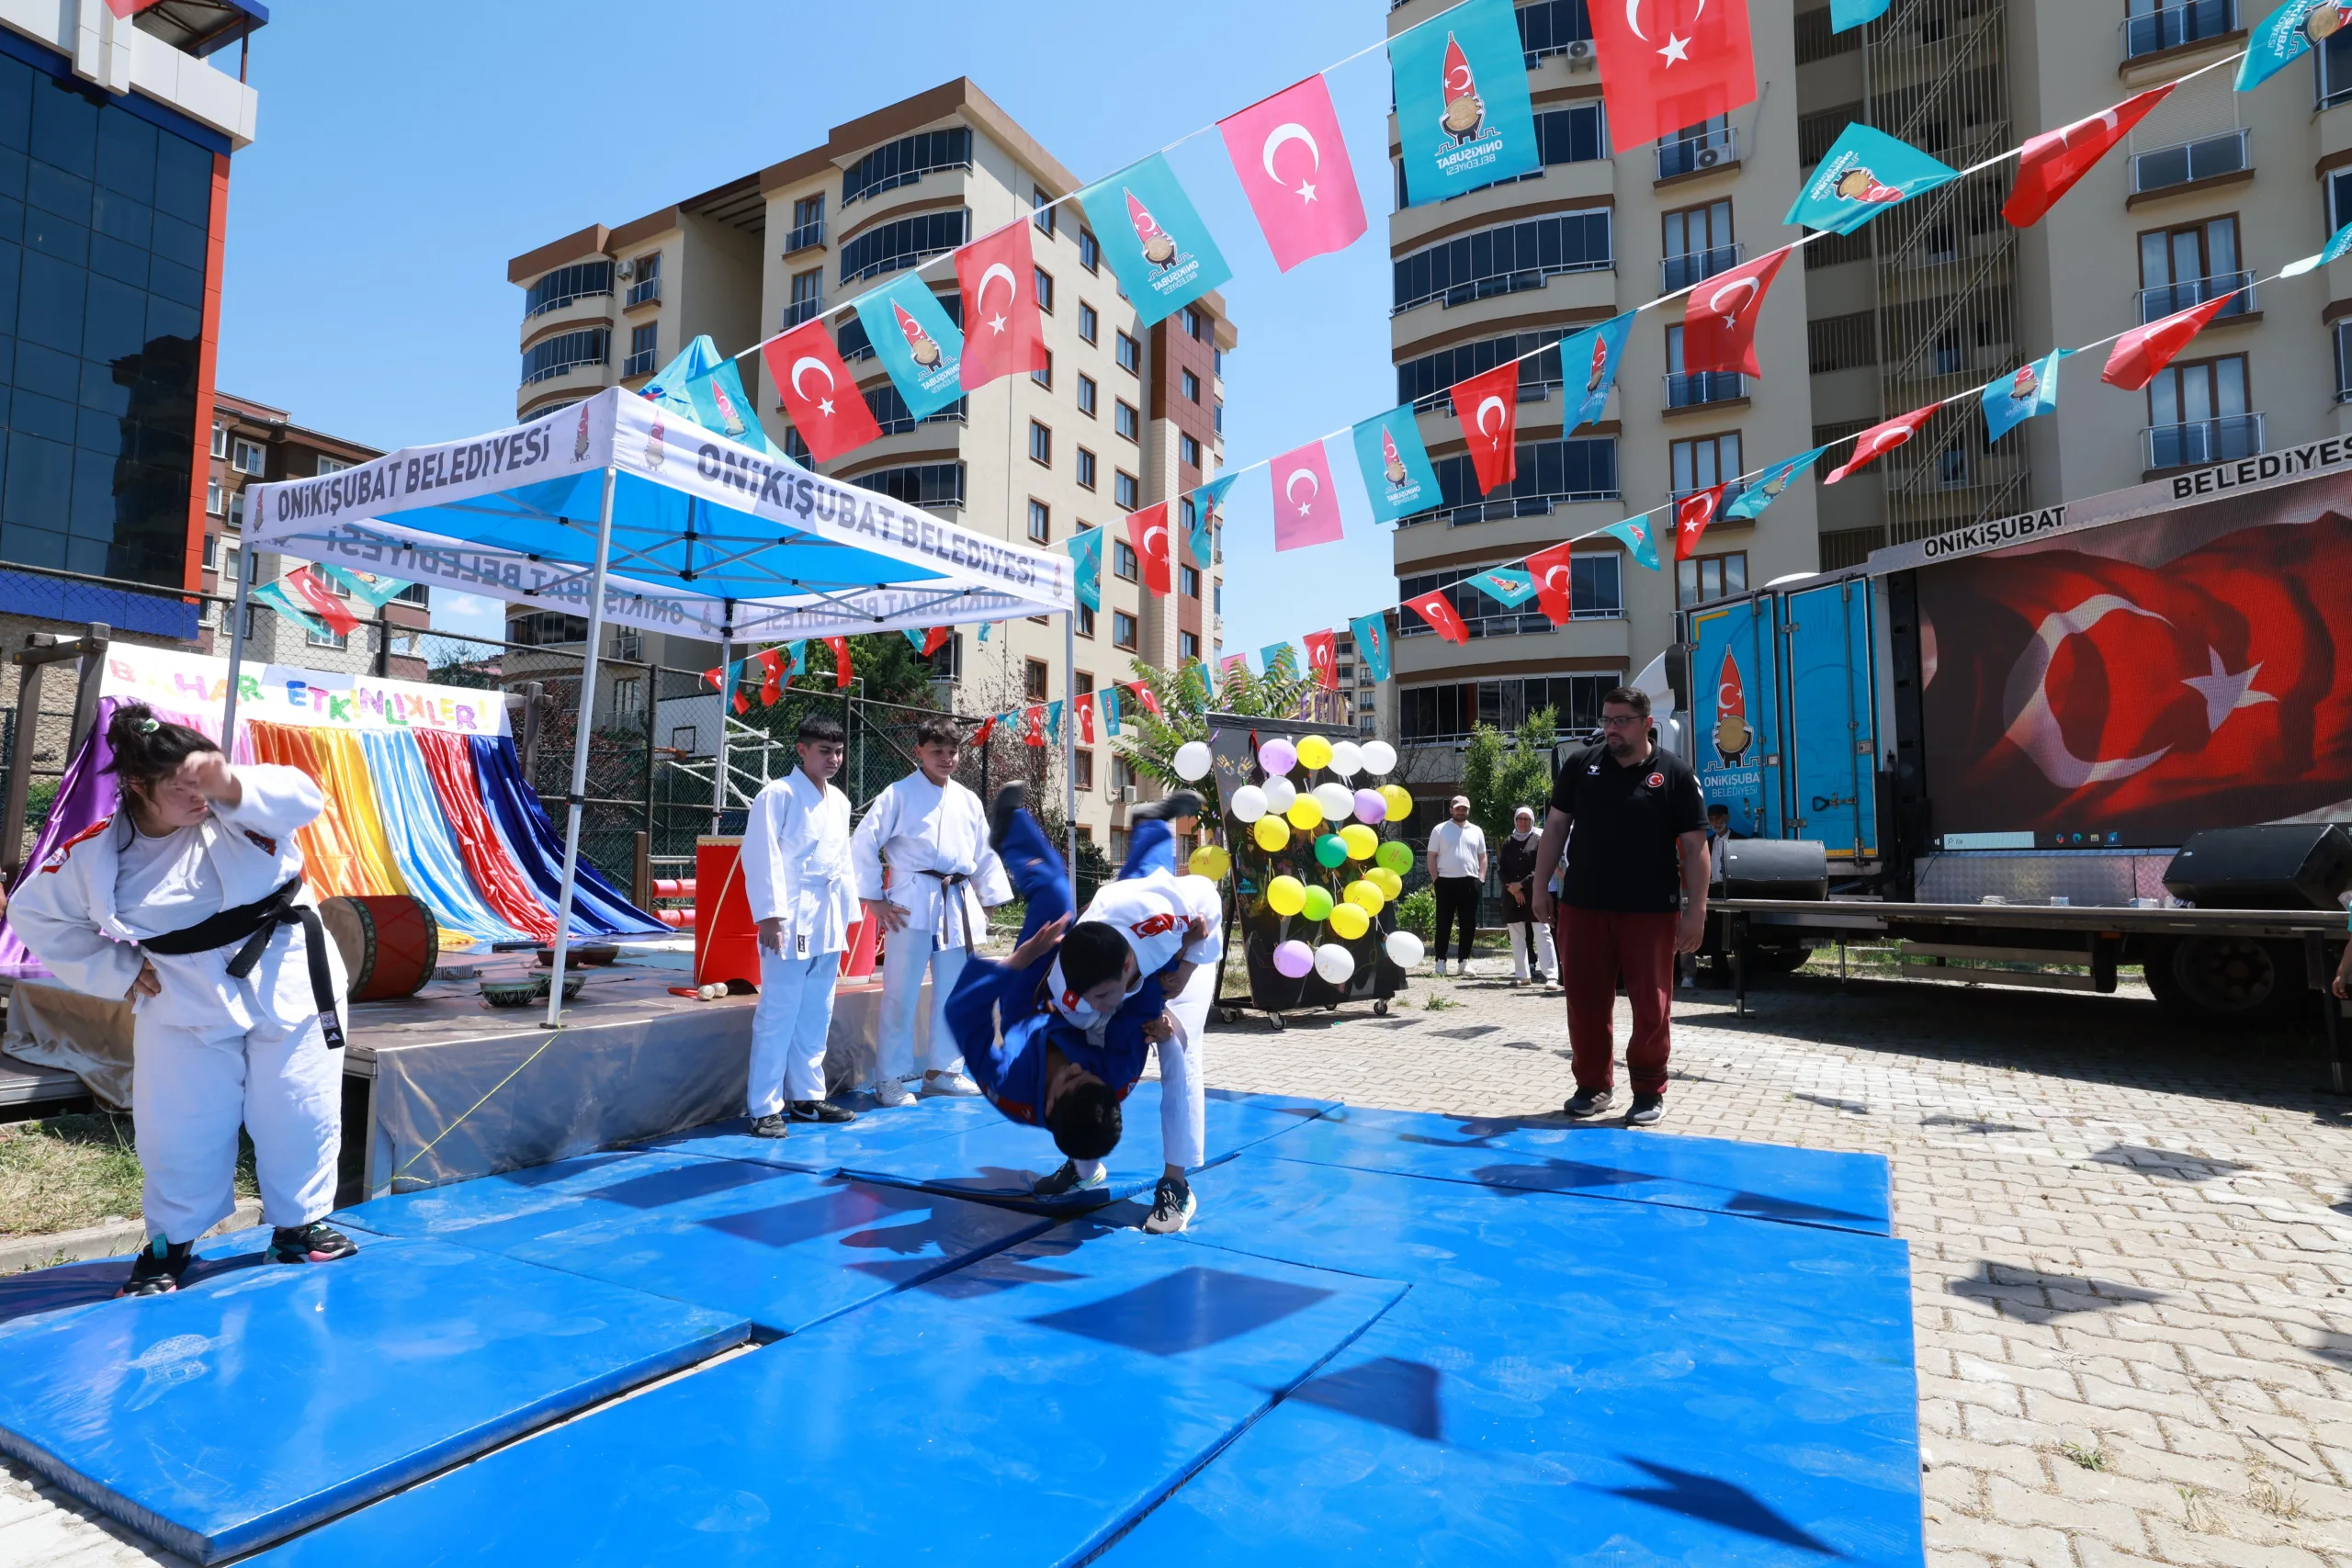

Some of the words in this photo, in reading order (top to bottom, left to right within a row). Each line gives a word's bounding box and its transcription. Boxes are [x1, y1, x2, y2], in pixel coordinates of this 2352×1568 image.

[277, 461, 402, 522] ONİKİŞUBAT
[405, 423, 552, 494] BELEDİYESİ
[696, 443, 895, 540] ONİKİŞUBAT
[901, 514, 1036, 587] BELEDİYESİ
[1924, 506, 2066, 558] ONİKİŞUBAT
[1704, 773, 1760, 787] ONİKİŞUBA
[1713, 785, 1758, 798] BELEDİYESİ
